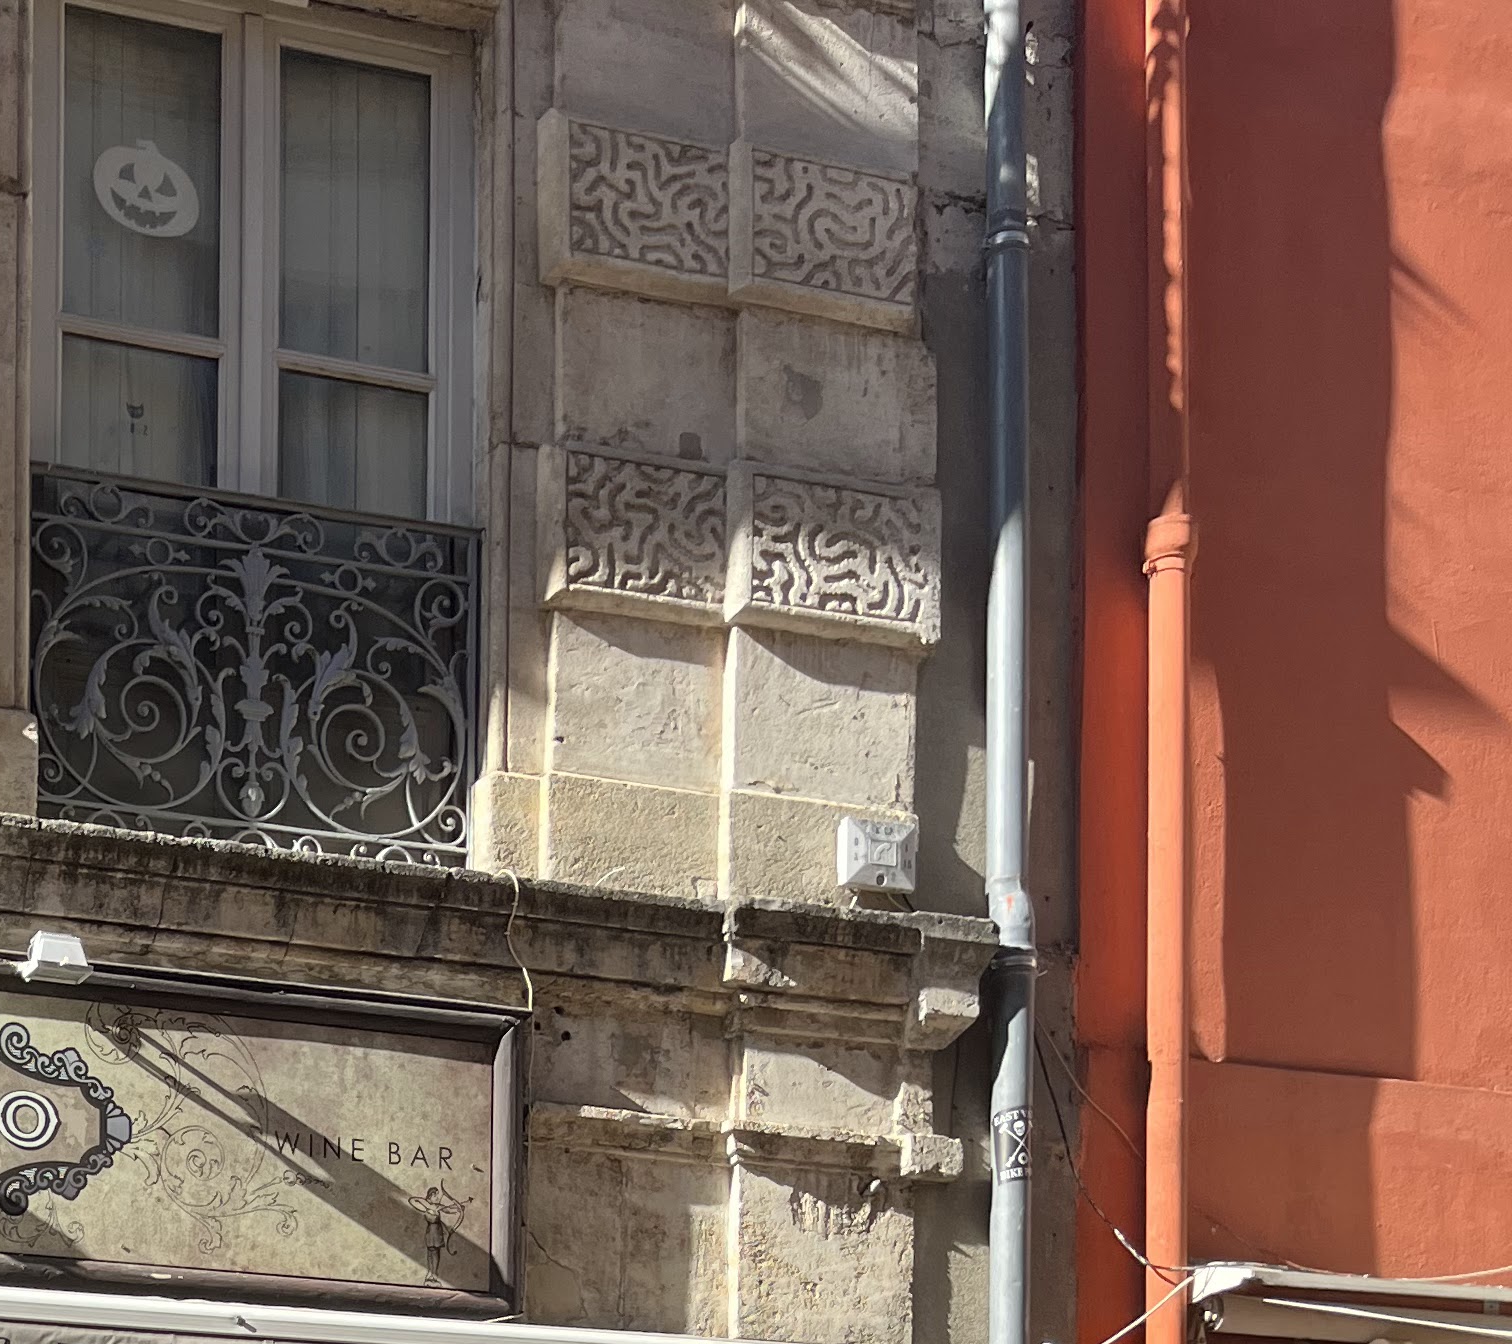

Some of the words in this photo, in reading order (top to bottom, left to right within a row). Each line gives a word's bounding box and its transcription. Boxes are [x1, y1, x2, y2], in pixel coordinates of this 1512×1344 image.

[993, 1109, 1020, 1127] EAST
[274, 1129, 365, 1163] WINE
[386, 1141, 455, 1172] BAR
[999, 1166, 1024, 1181] BIKE
